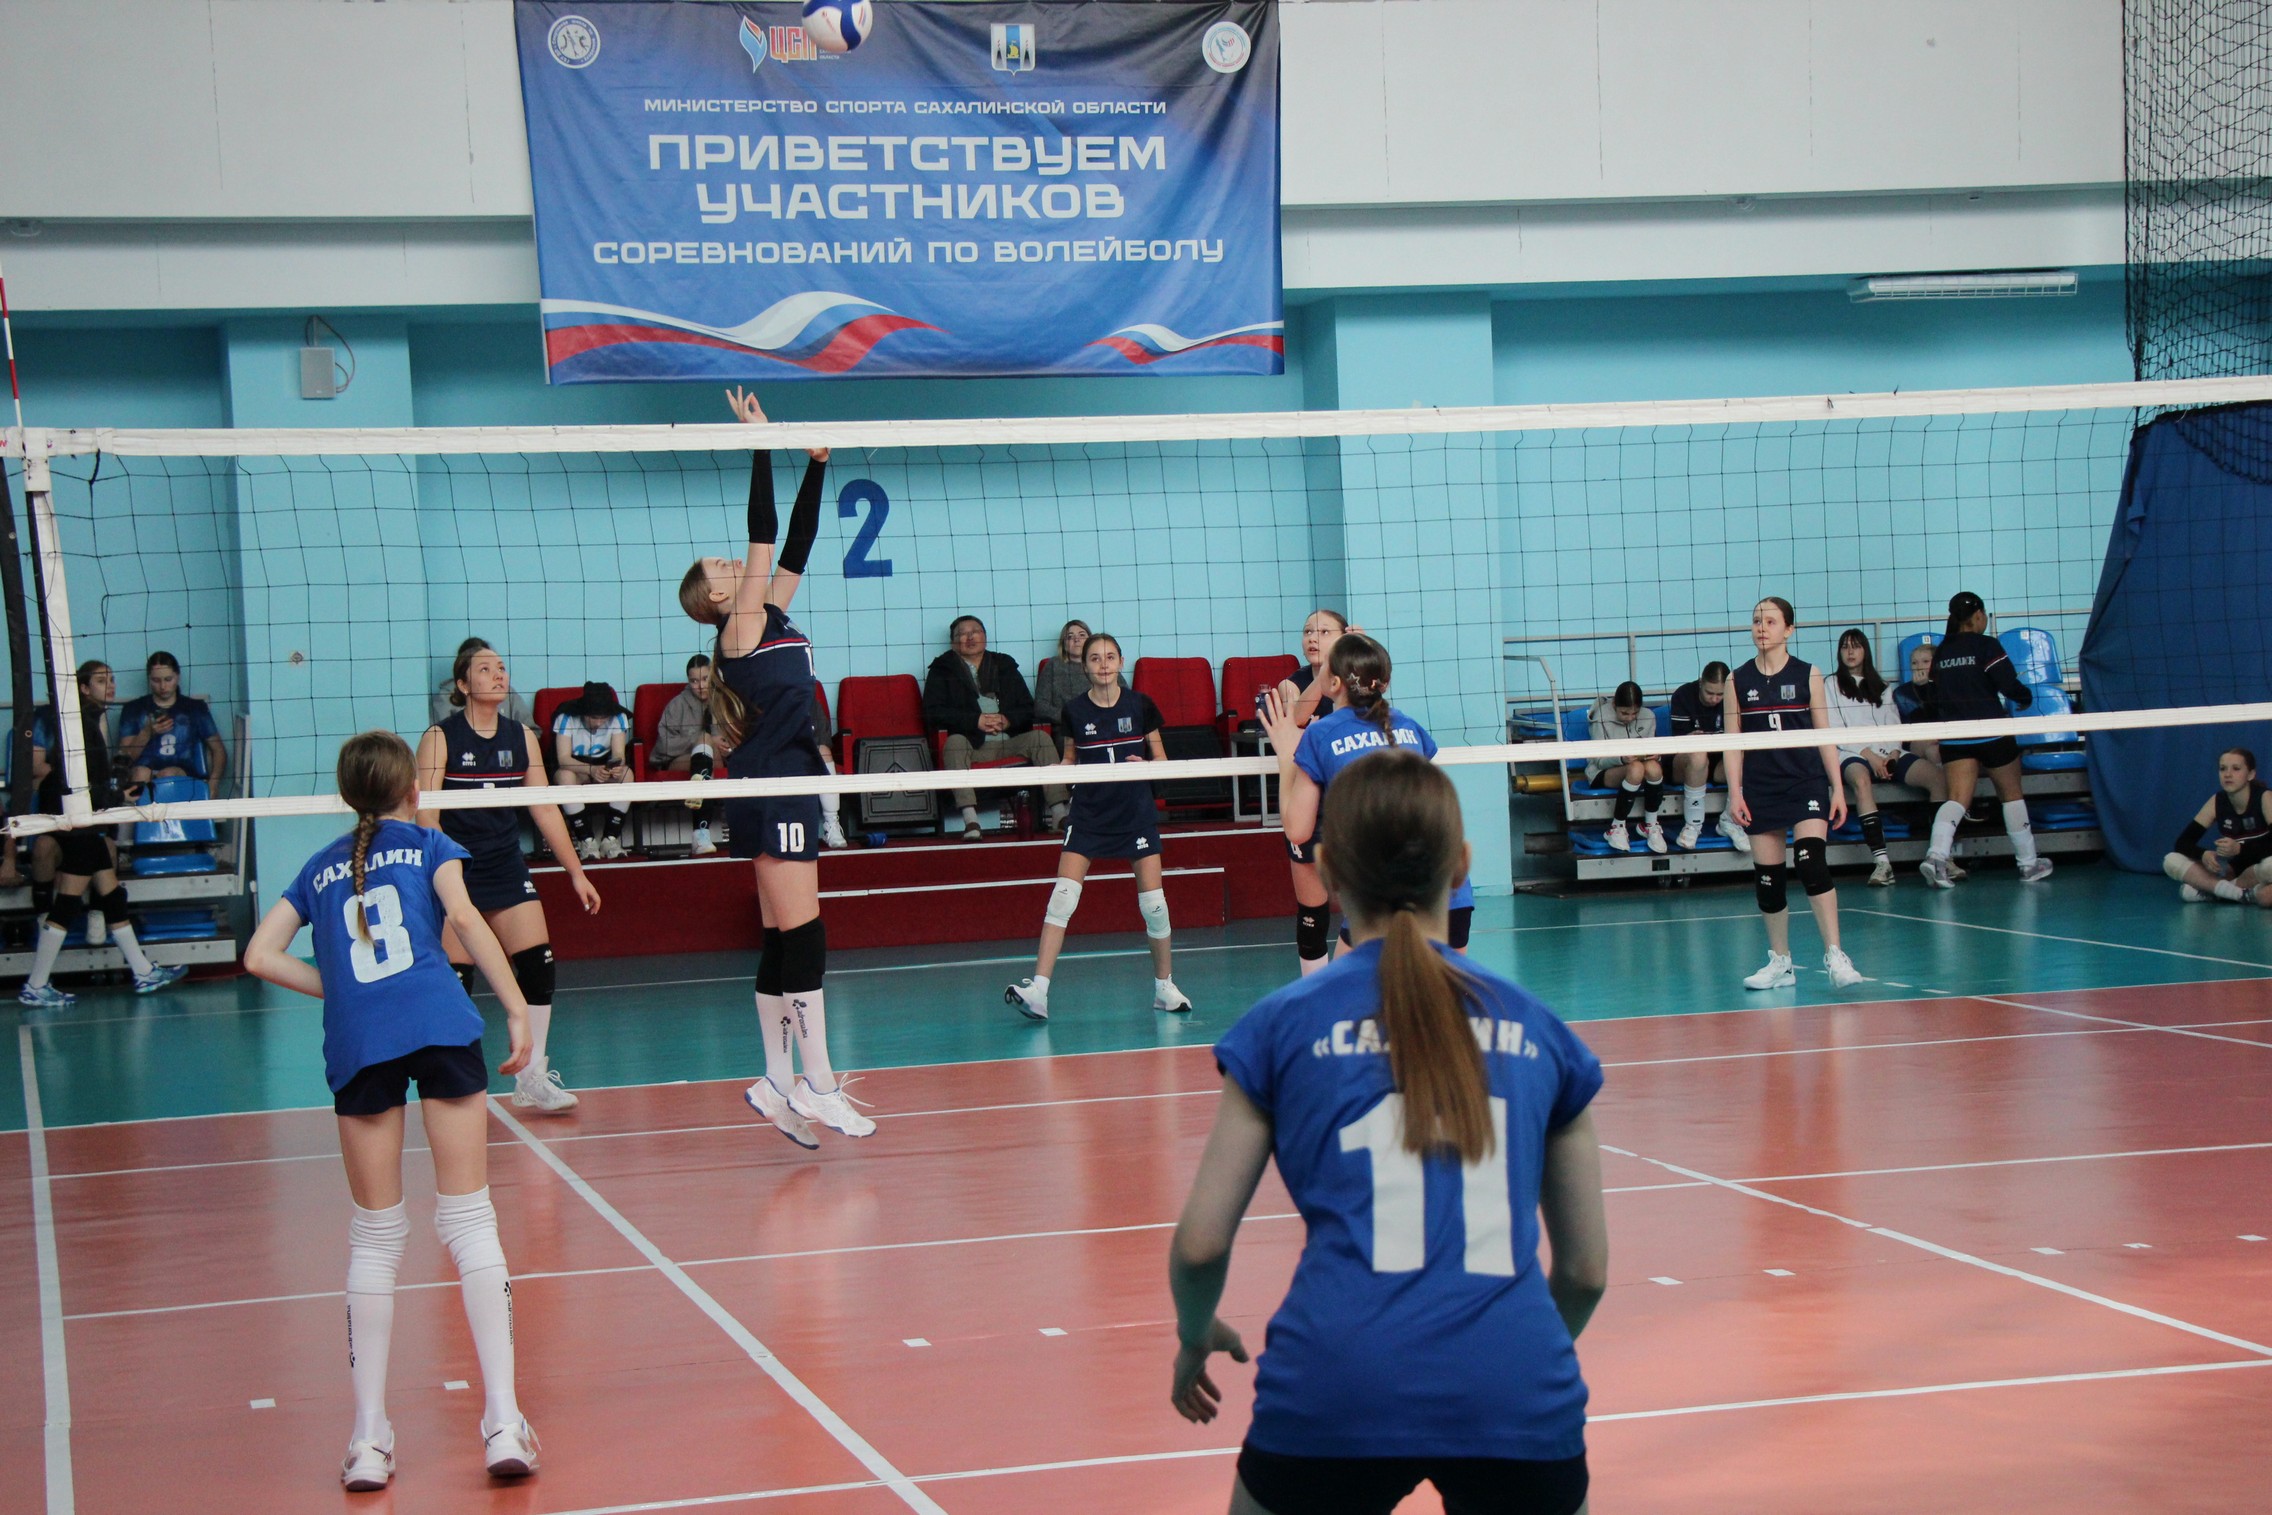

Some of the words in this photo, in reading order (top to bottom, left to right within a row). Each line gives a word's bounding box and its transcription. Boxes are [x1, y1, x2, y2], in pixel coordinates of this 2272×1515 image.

[644, 99, 818, 113] МИНИСТЕРСТВО
[825, 100, 908, 114] СПОРТА
[914, 99, 1065, 114] САХАЛИНСКОЙ
[1072, 101, 1167, 114] ОБЛАСТИ
[648, 134, 1166, 176] ПРИВЕТСТВУЕМ
[696, 183, 1125, 224] УЧАСТНИКОВ
[593, 237, 913, 264] СОРЕВНОВАНИЙ
[928, 241, 979, 263] ПО
[994, 236, 1223, 263] ВОЛЕЙБОЛУ
[838, 479, 893, 578] 2
[160, 734, 177, 756] 8
[777, 822, 805, 853] 10
[343, 884, 414, 984] 8
[1338, 1092, 1516, 1277] 11
